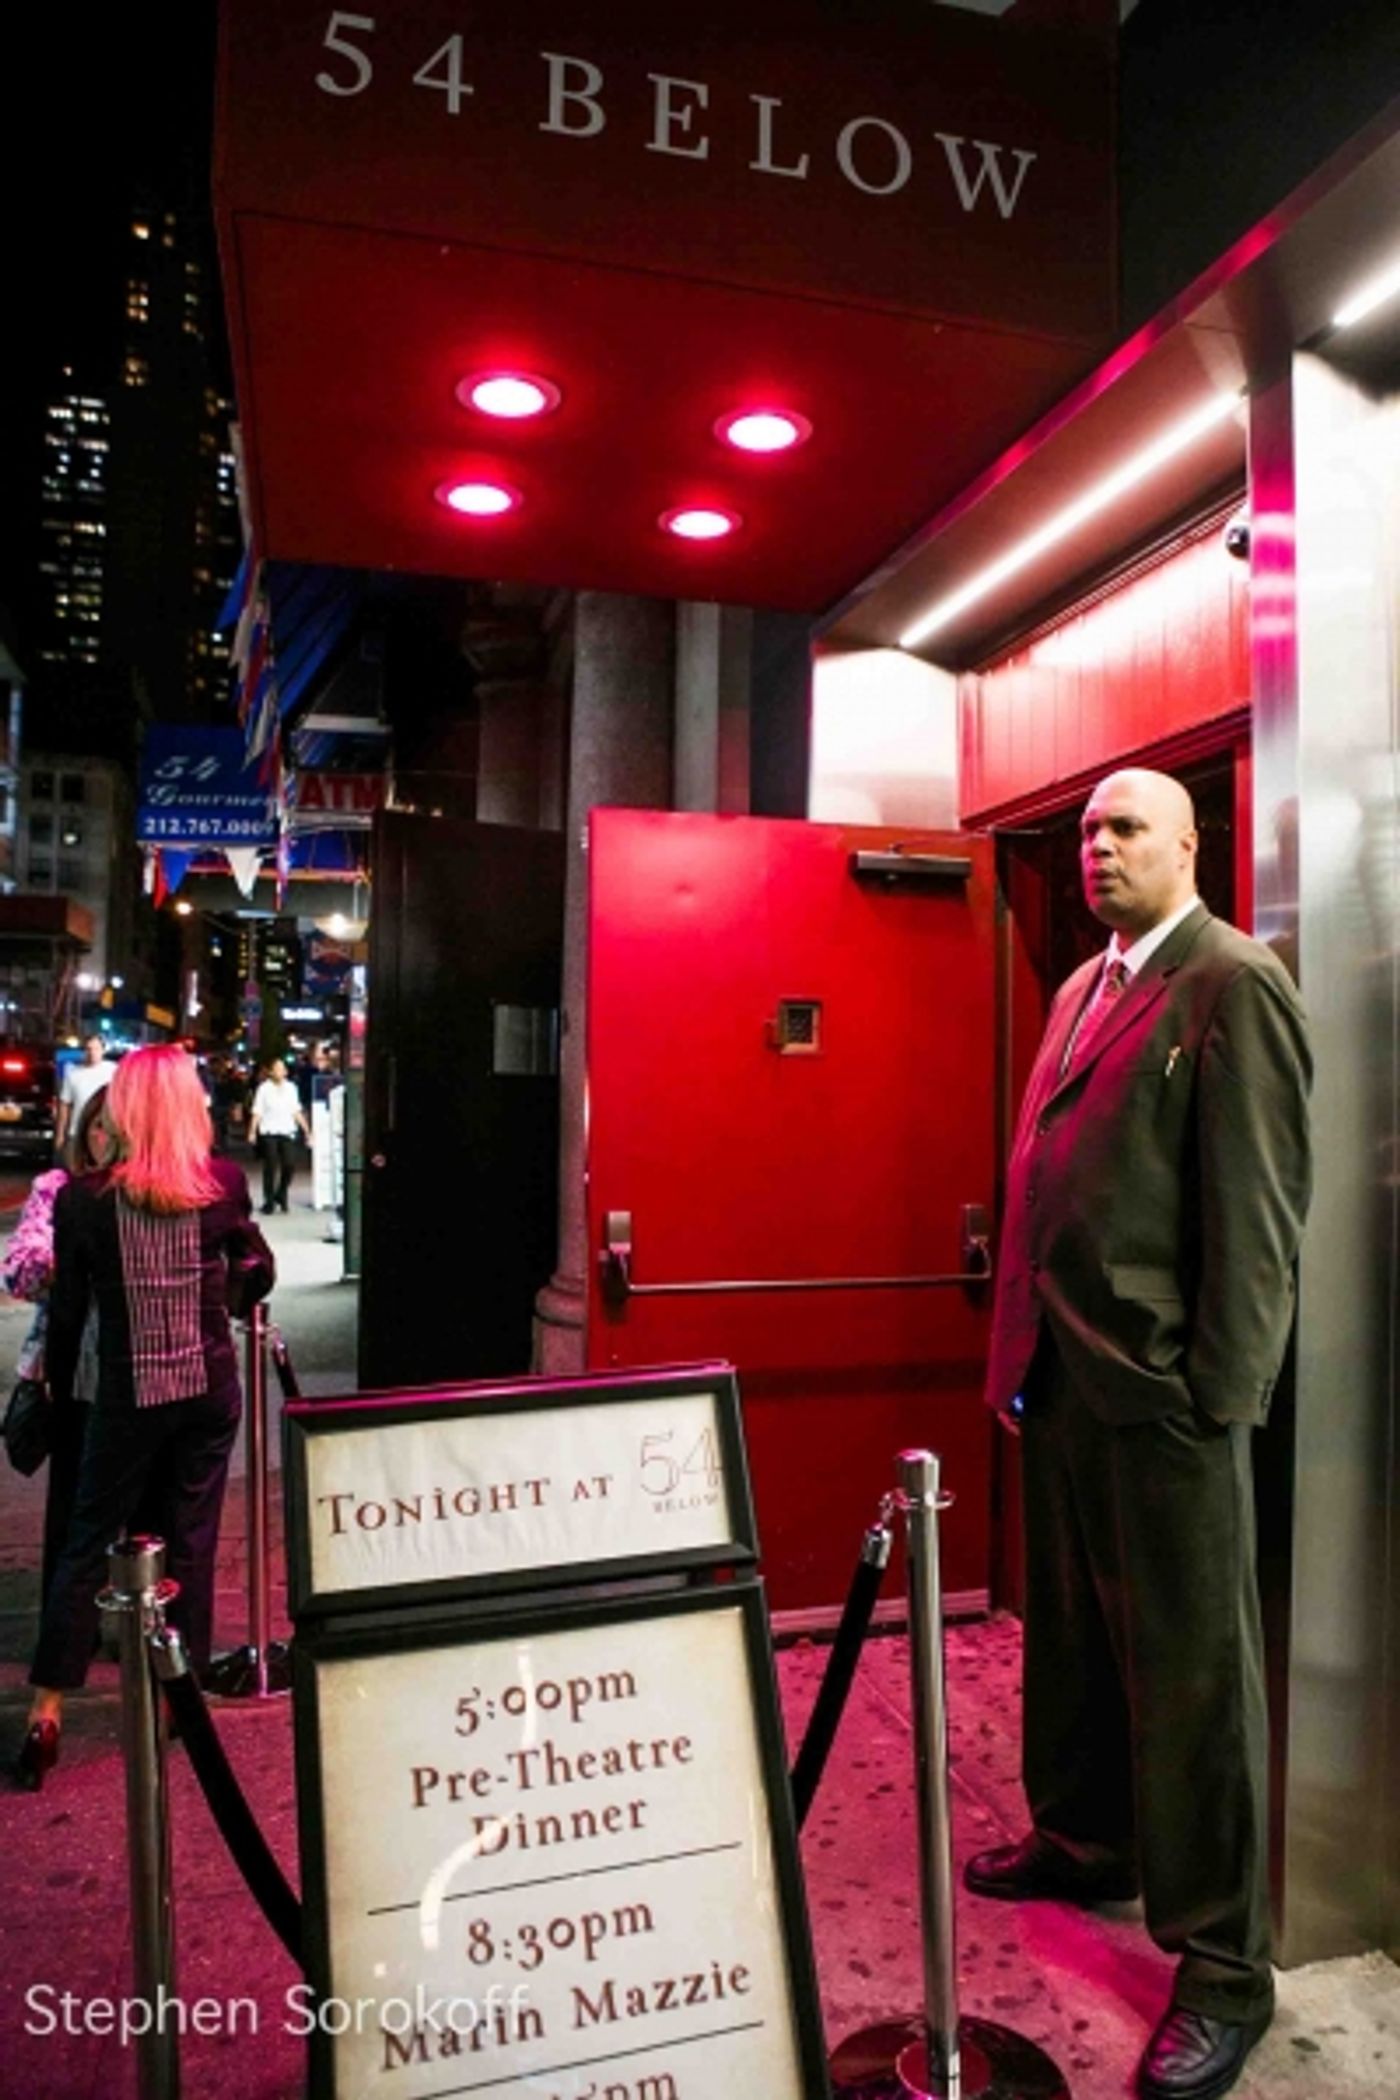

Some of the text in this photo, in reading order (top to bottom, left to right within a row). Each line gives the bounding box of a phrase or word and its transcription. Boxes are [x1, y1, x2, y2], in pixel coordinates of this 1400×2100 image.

[315, 10, 1038, 219] 54 BELOW
[153, 755, 220, 782] 54
[299, 773, 385, 811] ATM
[572, 1475, 614, 1500] AT
[639, 1427, 722, 1497] 54
[653, 1492, 719, 1513] BELOW
[454, 1668, 638, 1737] 5:00pm
[411, 1734, 695, 1809] Pre-Theatre
[471, 1797, 648, 1858] Dinner
[467, 1902, 655, 1972] 8:30pm
[380, 1959, 752, 2073] Marin Mazzie
